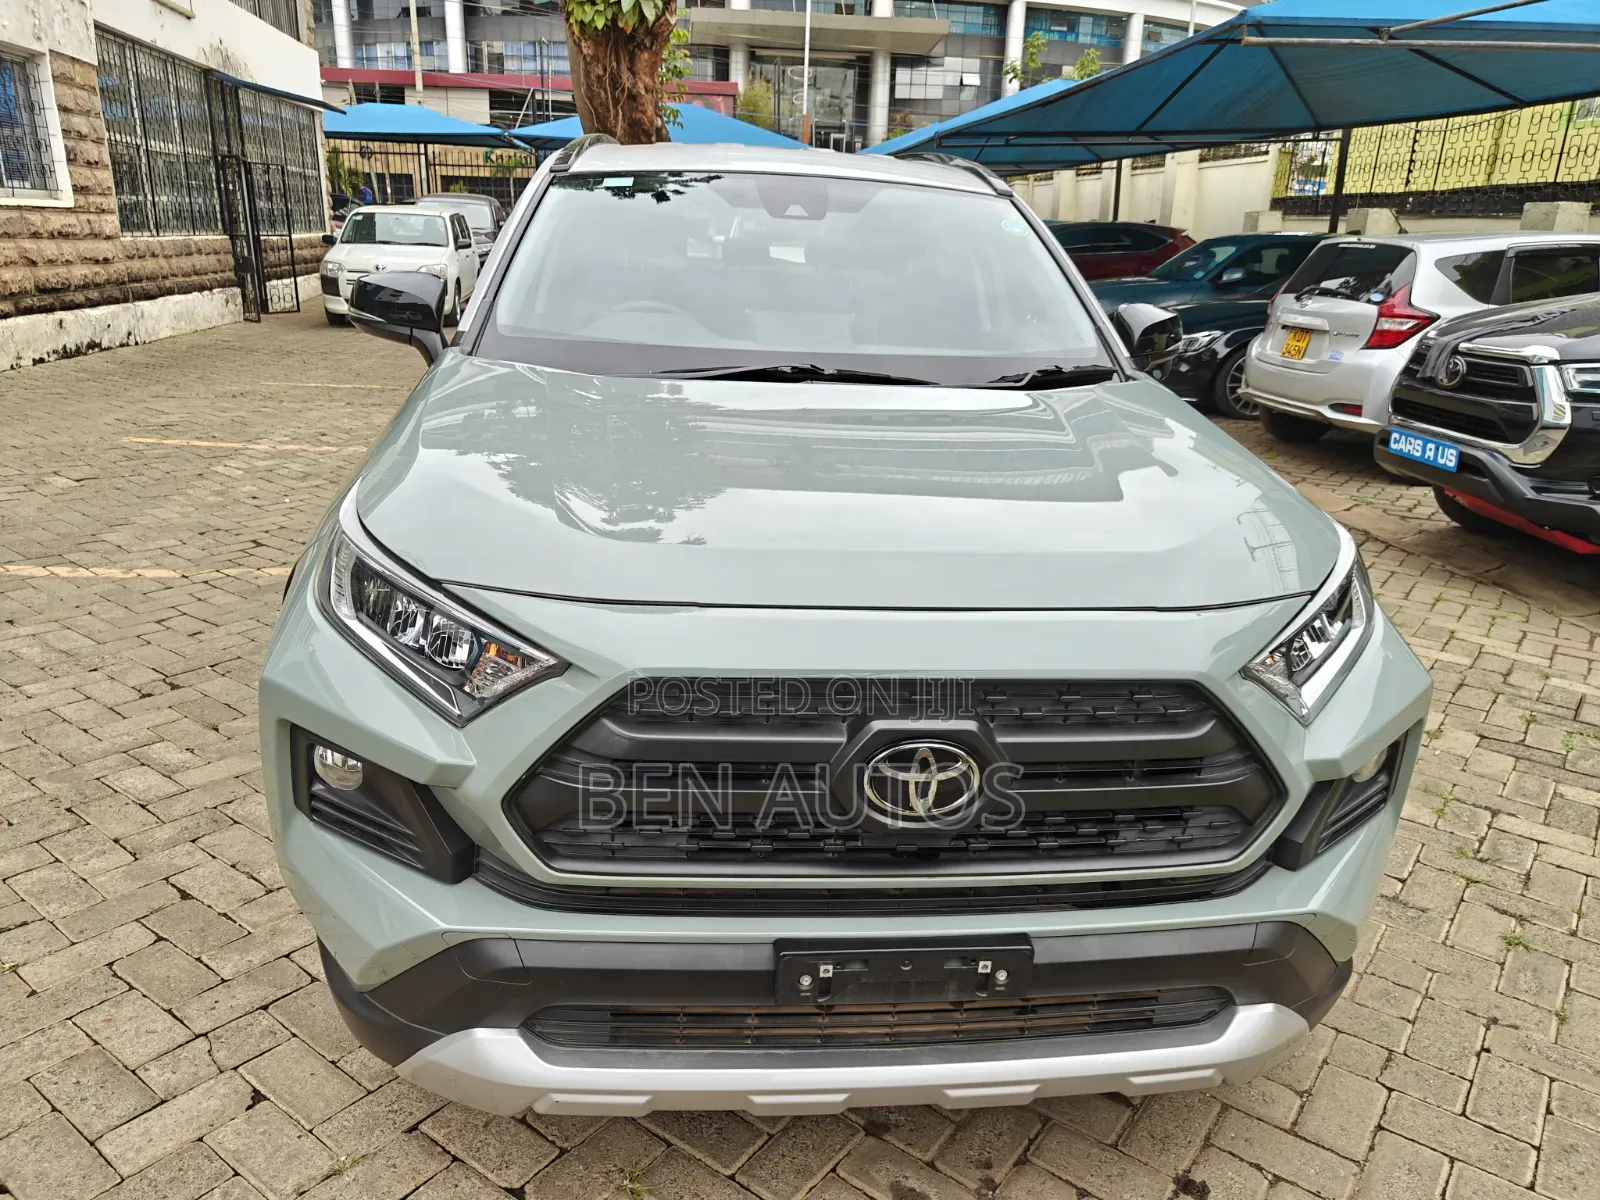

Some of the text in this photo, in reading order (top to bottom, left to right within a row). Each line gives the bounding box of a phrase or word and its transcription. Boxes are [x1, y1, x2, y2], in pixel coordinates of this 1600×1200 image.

[1066, 33, 1077, 43] of
[1390, 432, 1423, 457] CARS
[1437, 446, 1457, 467] US
